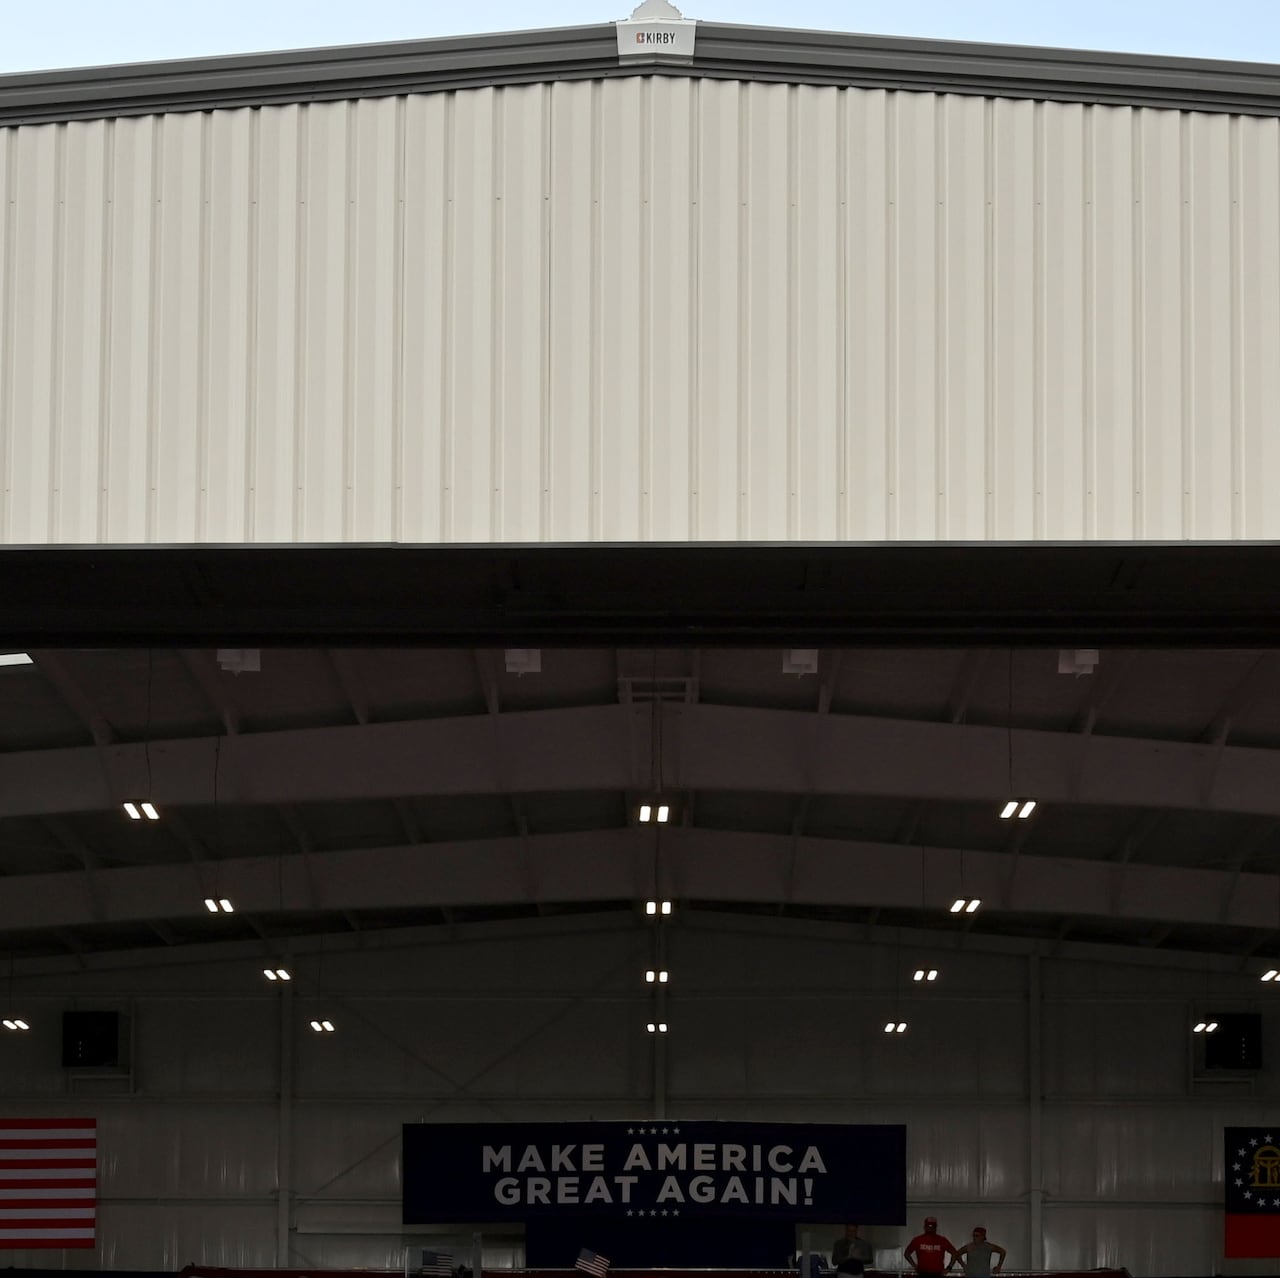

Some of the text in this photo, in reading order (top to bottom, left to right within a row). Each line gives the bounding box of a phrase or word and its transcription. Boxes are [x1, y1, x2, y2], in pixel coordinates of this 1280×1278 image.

[646, 33, 675, 44] KIRBY
[483, 1143, 828, 1173] MAKE AMERICA
[494, 1175, 814, 1206] GREAT AGAIN!
